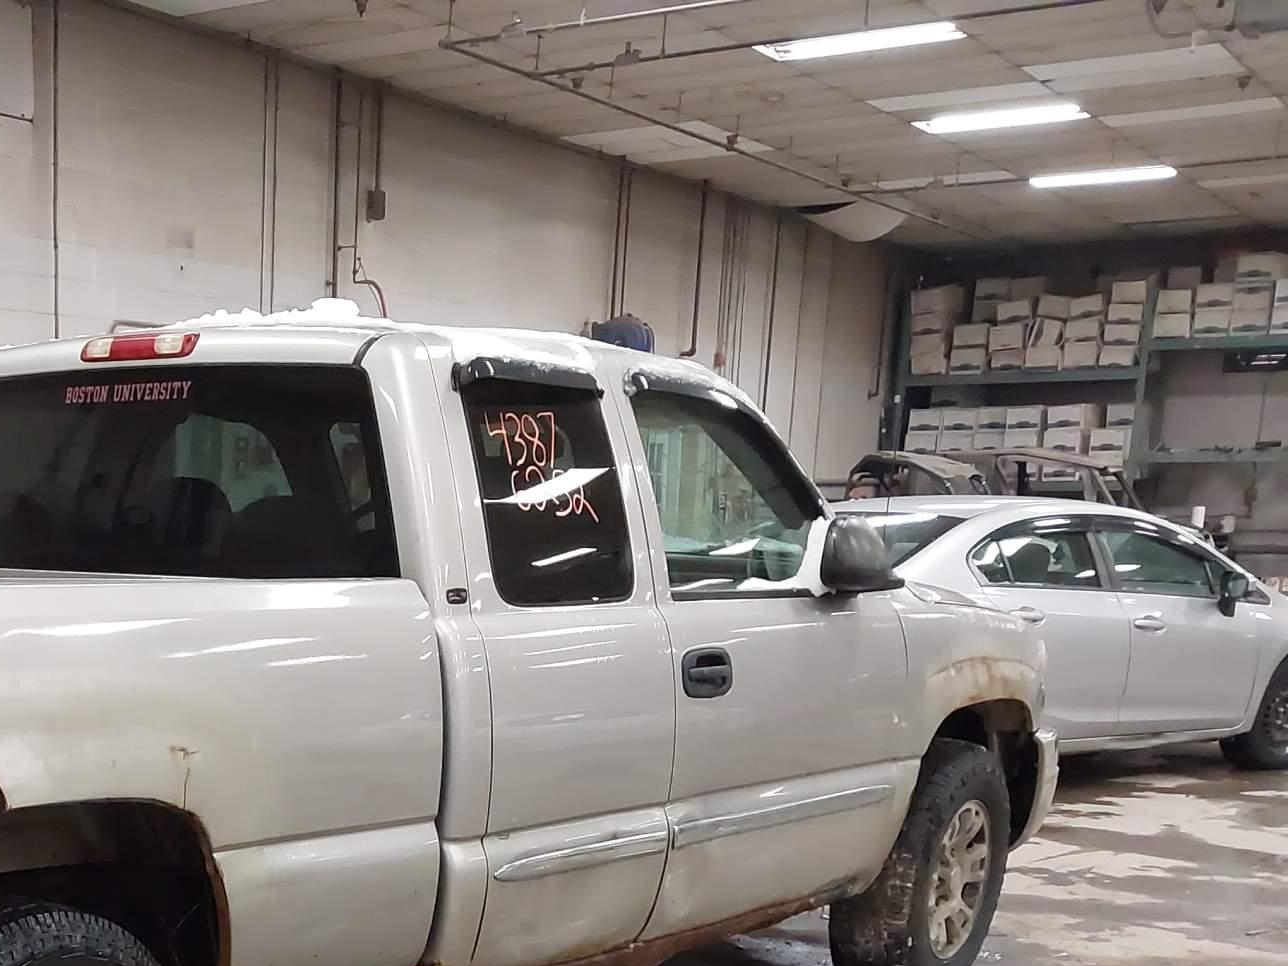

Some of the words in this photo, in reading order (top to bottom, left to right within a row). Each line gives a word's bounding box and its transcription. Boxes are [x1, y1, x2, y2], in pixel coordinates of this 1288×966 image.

[65, 385, 109, 404] BOSTON
[113, 381, 192, 402] UNIVERSITY
[483, 411, 556, 469] 4387
